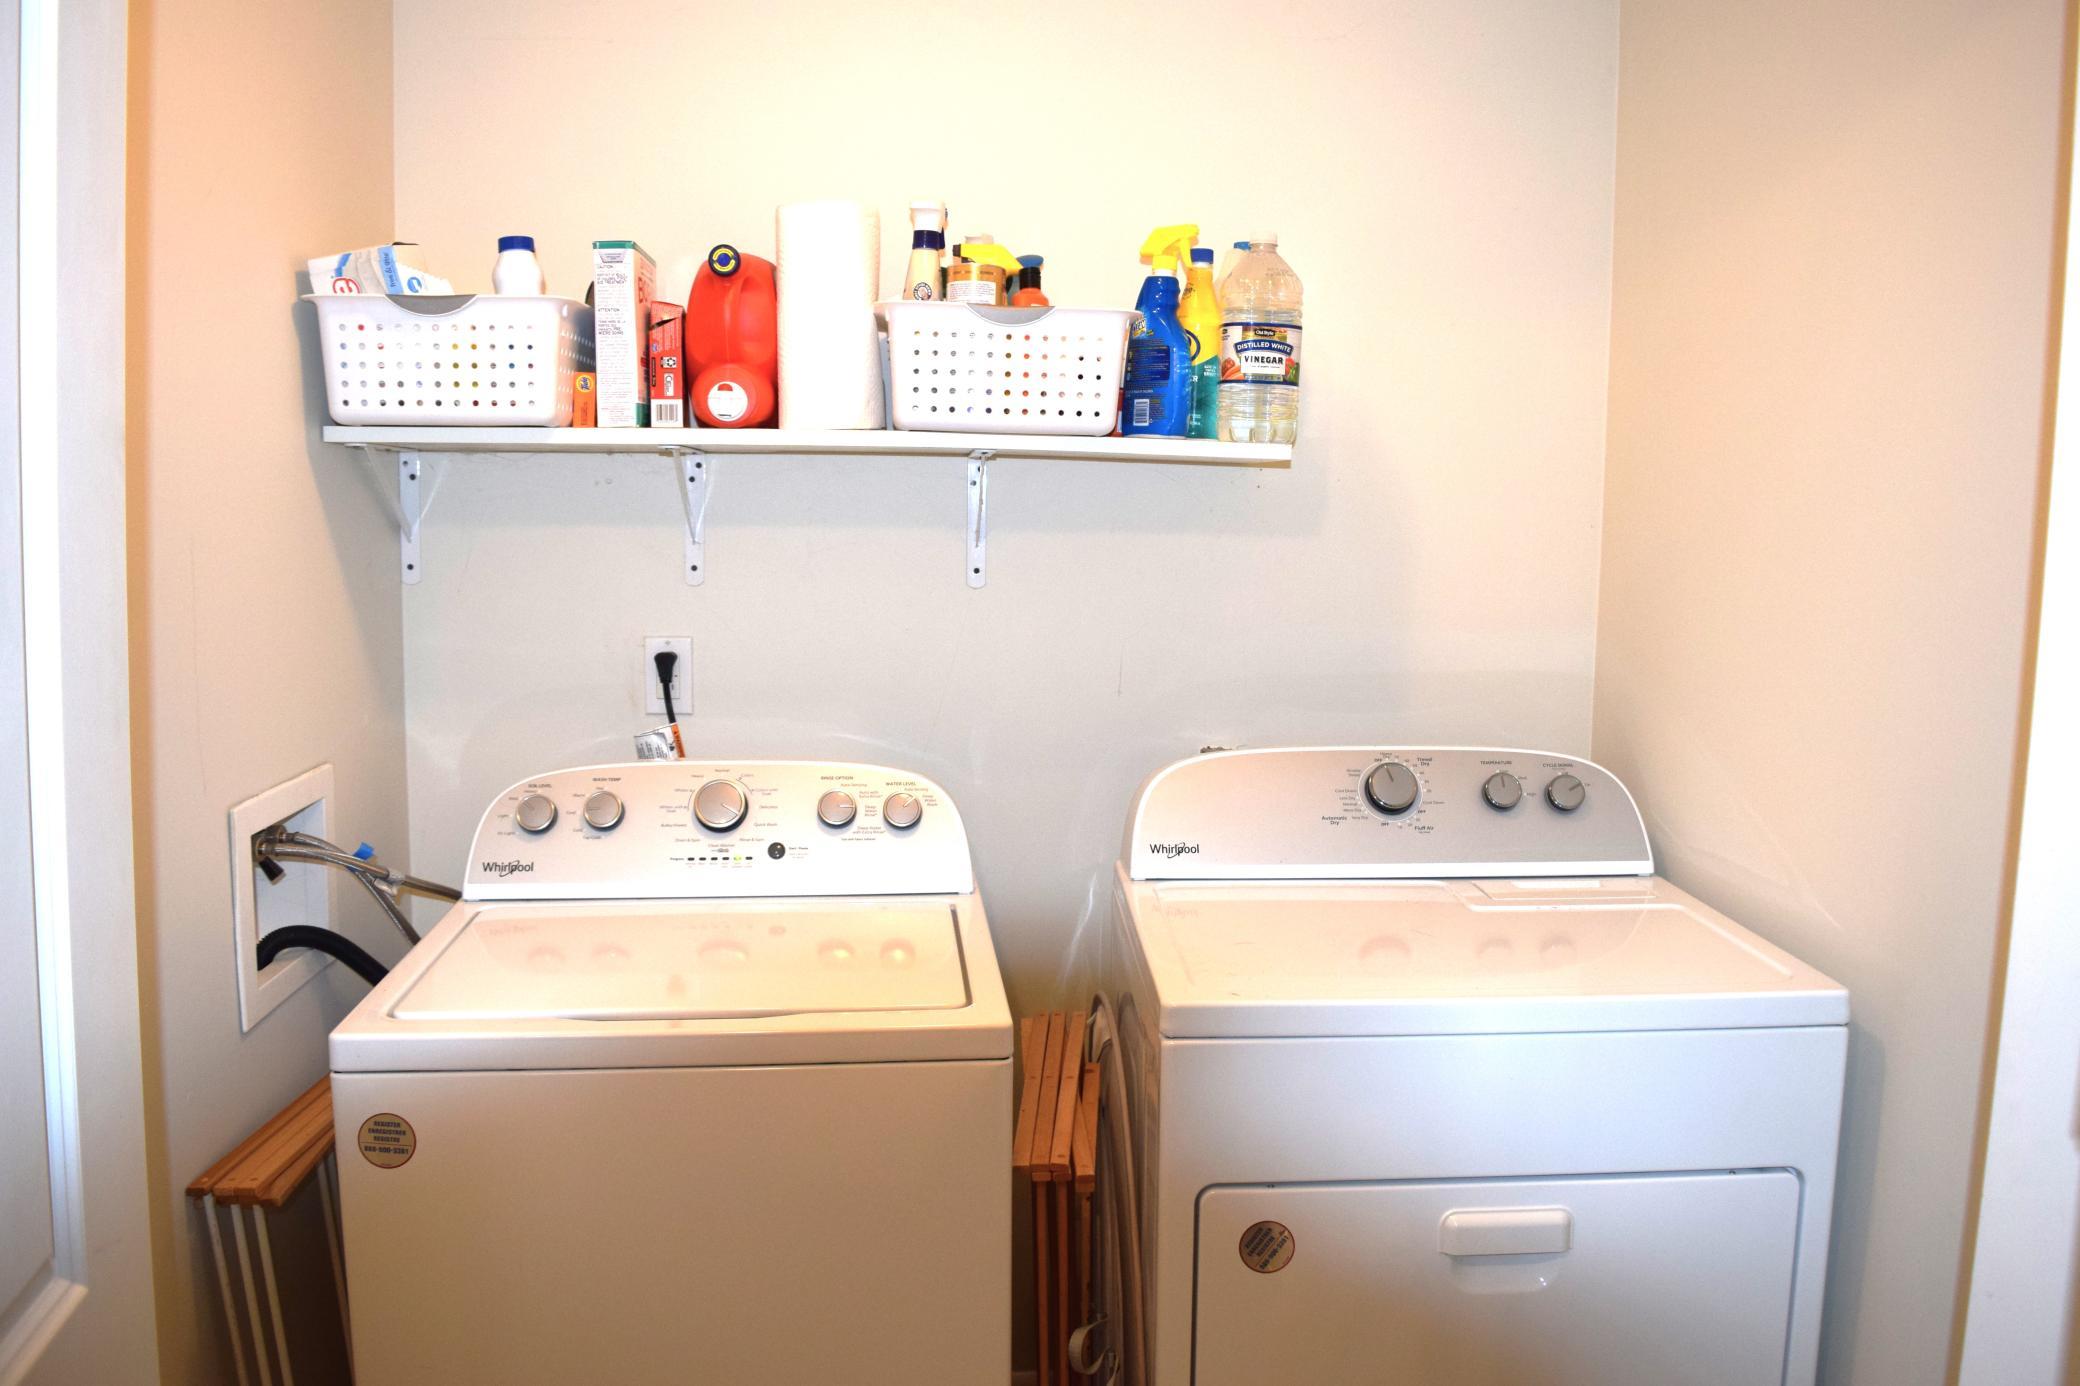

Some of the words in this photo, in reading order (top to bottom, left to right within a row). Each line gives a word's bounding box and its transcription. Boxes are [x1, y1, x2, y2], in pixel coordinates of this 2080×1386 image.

[1237, 341, 1270, 351] DISTILLED
[1271, 343, 1292, 353] WHITE
[1244, 355, 1284, 364] VINEGAR
[1149, 842, 1200, 859] Whirlpool
[482, 860, 534, 877] Whirlpool
